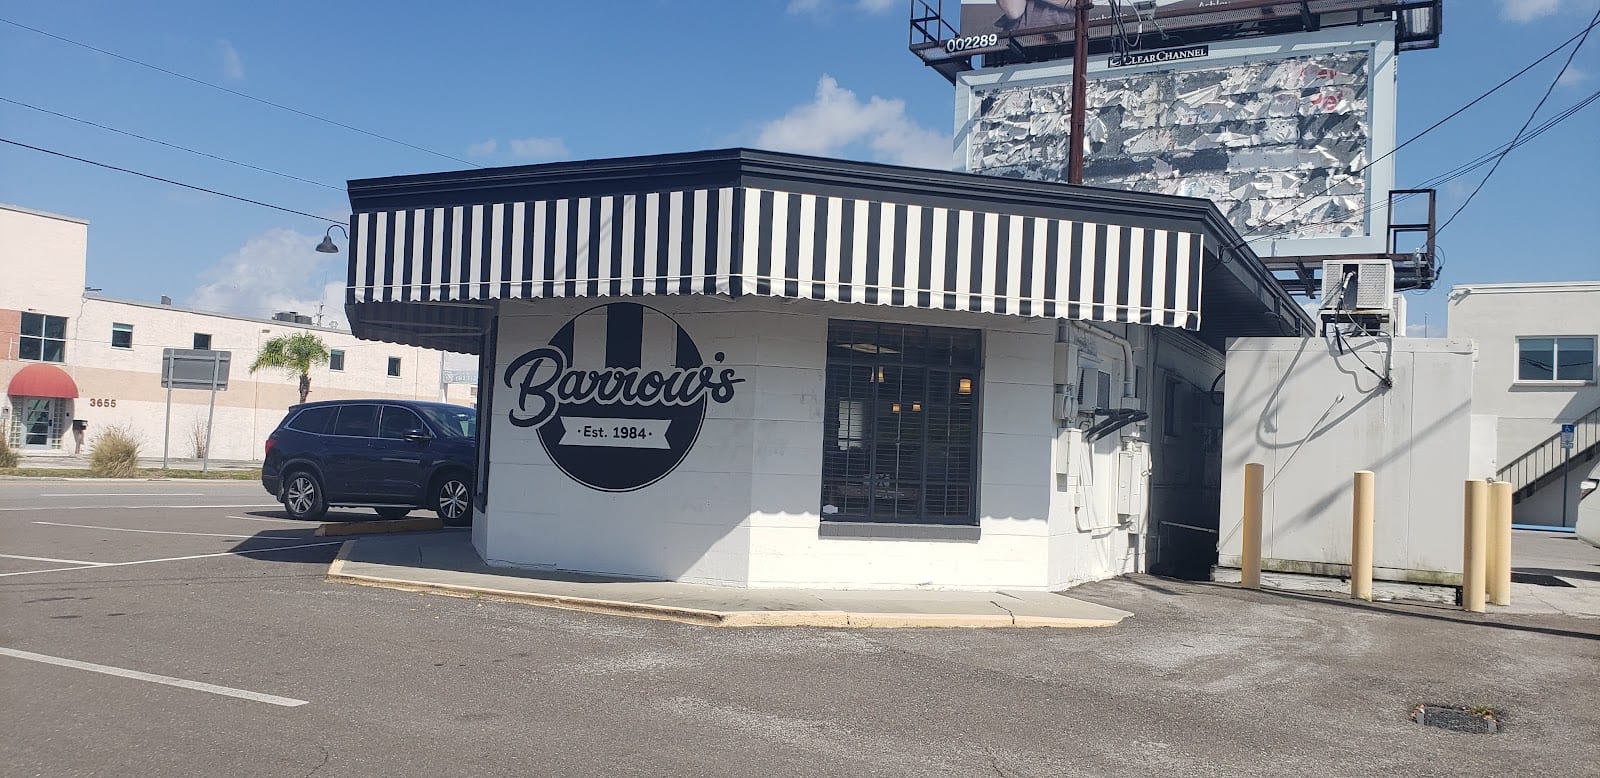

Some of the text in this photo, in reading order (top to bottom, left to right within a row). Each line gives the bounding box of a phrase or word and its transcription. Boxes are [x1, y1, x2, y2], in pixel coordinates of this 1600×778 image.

[946, 33, 998, 52] 002289
[503, 348, 746, 427] Barrow's
[89, 398, 117, 408] 3655
[583, 425, 647, 440] Est. 1984
